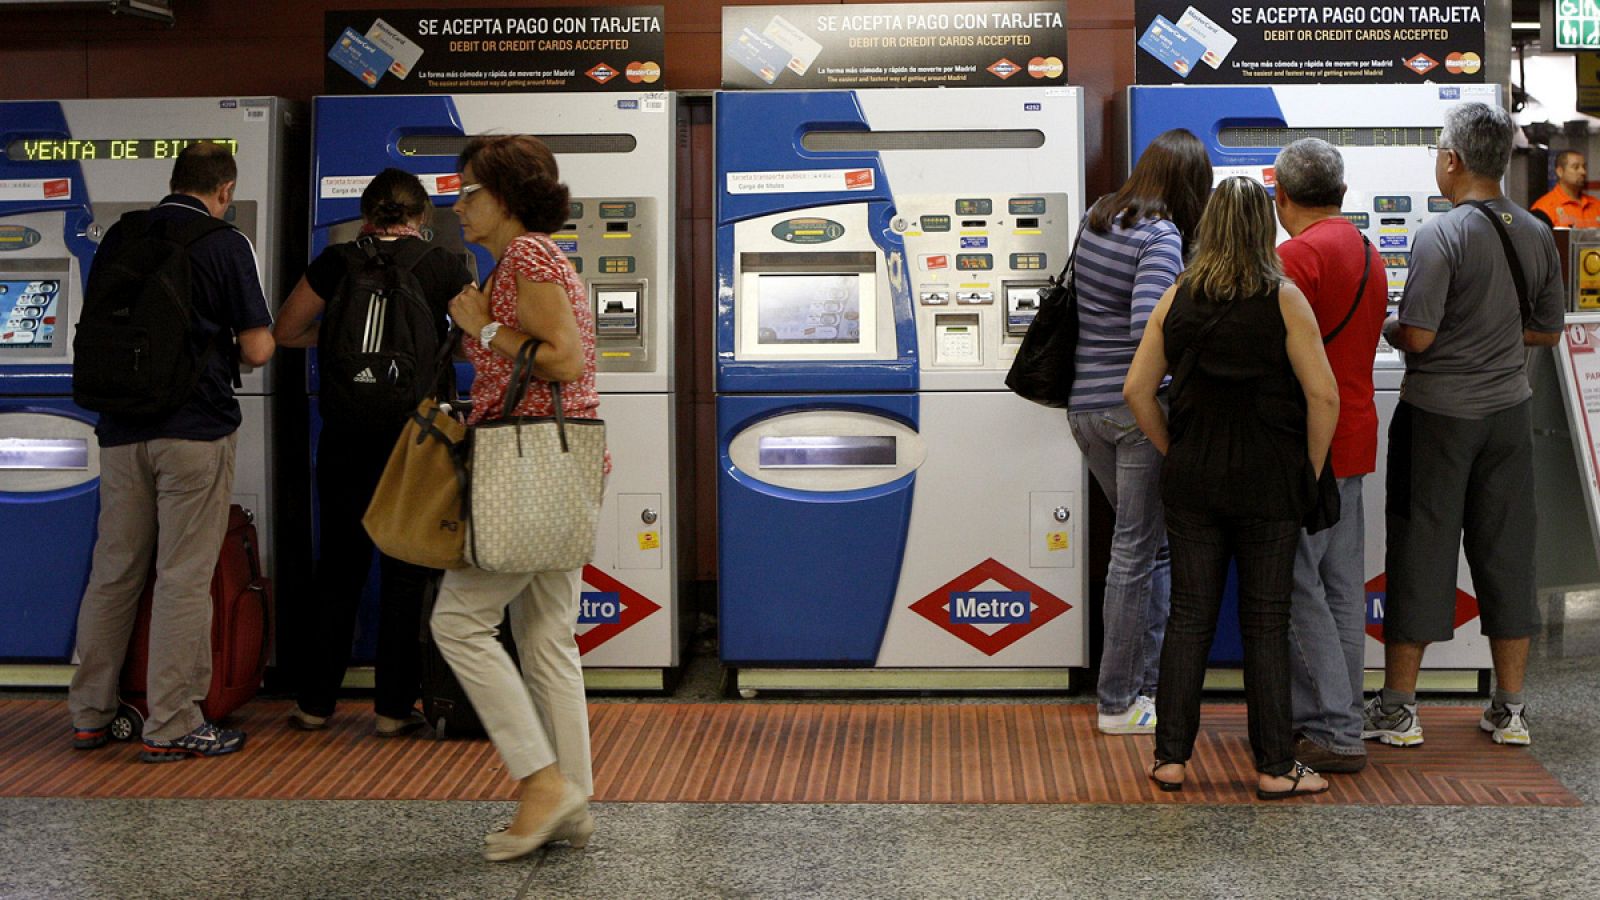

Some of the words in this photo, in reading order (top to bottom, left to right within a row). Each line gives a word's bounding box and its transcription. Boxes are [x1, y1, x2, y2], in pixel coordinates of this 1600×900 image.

[816, 16, 838, 31] SE
[842, 15, 902, 30] ACEPTA
[907, 14, 949, 30] PAGO
[954, 13, 988, 29] CON
[992, 12, 1064, 28] TARJETA
[1231, 7, 1252, 24] SE
[1256, 7, 1318, 24] ACEPTA
[1322, 7, 1366, 23] PAGO
[1370, 7, 1404, 23] CON
[1409, 6, 1480, 22] TARJETA
[418, 19, 439, 36] SE
[442, 19, 503, 35] ACEPTA
[507, 18, 549, 34] PAGO
[553, 17, 586, 33] CON
[590, 17, 661, 33] TARJETA
[1264, 30, 1295, 41] DEBIT
[1297, 30, 1312, 41] OR
[1314, 30, 1353, 40] CREDIT
[1356, 29, 1391, 40] CARDS
[1393, 29, 1448, 40] ACCEPTED
[450, 41, 480, 52] DEBIT
[482, 40, 497, 52] OR
[499, 40, 536, 51] CREDIT
[538, 40, 573, 51] CARDS
[575, 40, 629, 50] ACCEPTED
[849, 37, 880, 48] DEBIT
[882, 36, 897, 48] OR
[899, 36, 936, 47] CREDIT
[939, 35, 974, 46] CARDS
[976, 35, 1031, 46] ACCEPTED
[24, 140, 96, 160] VENTA
[111, 140, 139, 159] DE
[331, 187, 349, 195] Carga
[577, 600, 615, 618] tro
[956, 597, 1024, 618] Metro
